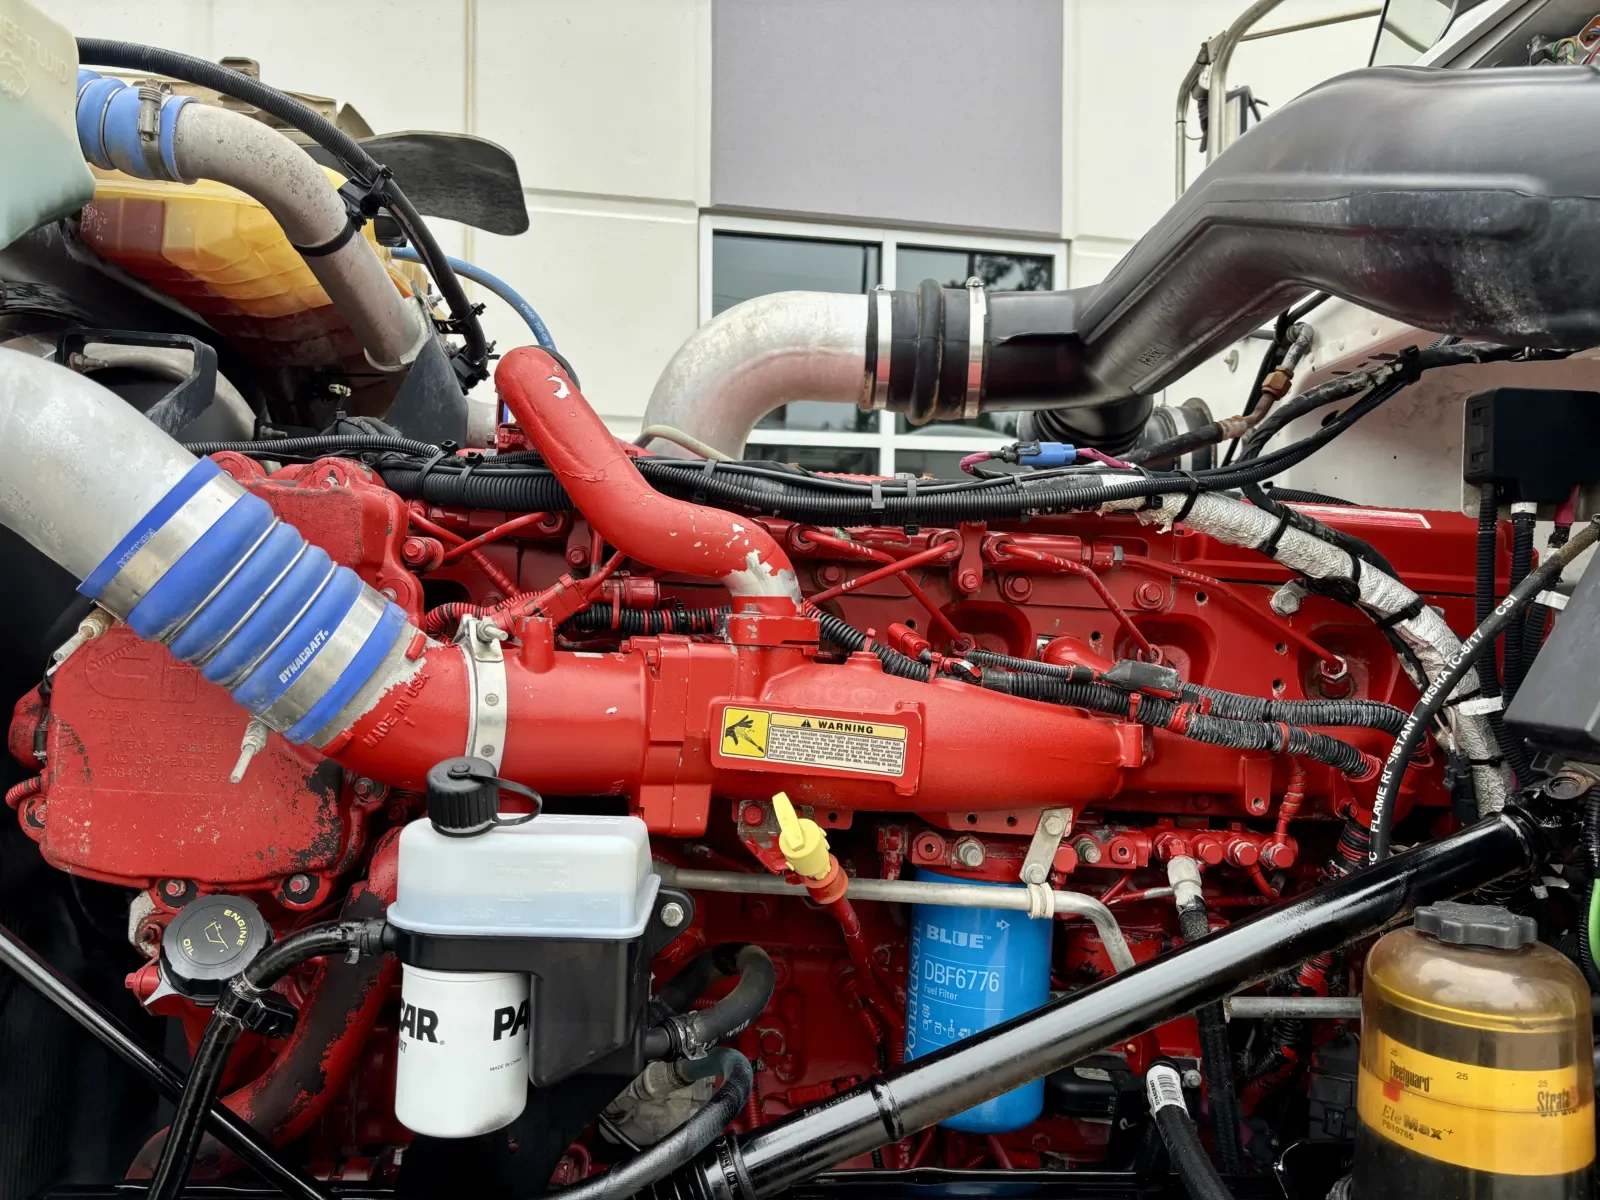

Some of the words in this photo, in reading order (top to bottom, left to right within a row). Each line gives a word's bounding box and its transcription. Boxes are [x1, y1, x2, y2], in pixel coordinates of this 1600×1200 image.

[364, 716, 391, 749] MADE
[393, 698, 411, 717] IN
[405, 671, 431, 699] USA
[1370, 786, 1387, 832] FLAME
[1420, 670, 1452, 705] MSHA
[1448, 629, 1483, 670] IC-8/17
[1495, 595, 1518, 616] CSI
[818, 720, 874, 734] WARNING
[223, 909, 248, 947] ENGINE
[183, 938, 195, 956] OIL
[924, 959, 1000, 992] DBF6776
[924, 983, 938, 996] Fuel
[938, 986, 958, 1001] Filter
[489, 1063, 505, 1072] MADE
[1390, 1059, 1430, 1093] Fleetguard
[1456, 1071, 1469, 1081] 25
[1537, 1080, 1549, 1088] 25
